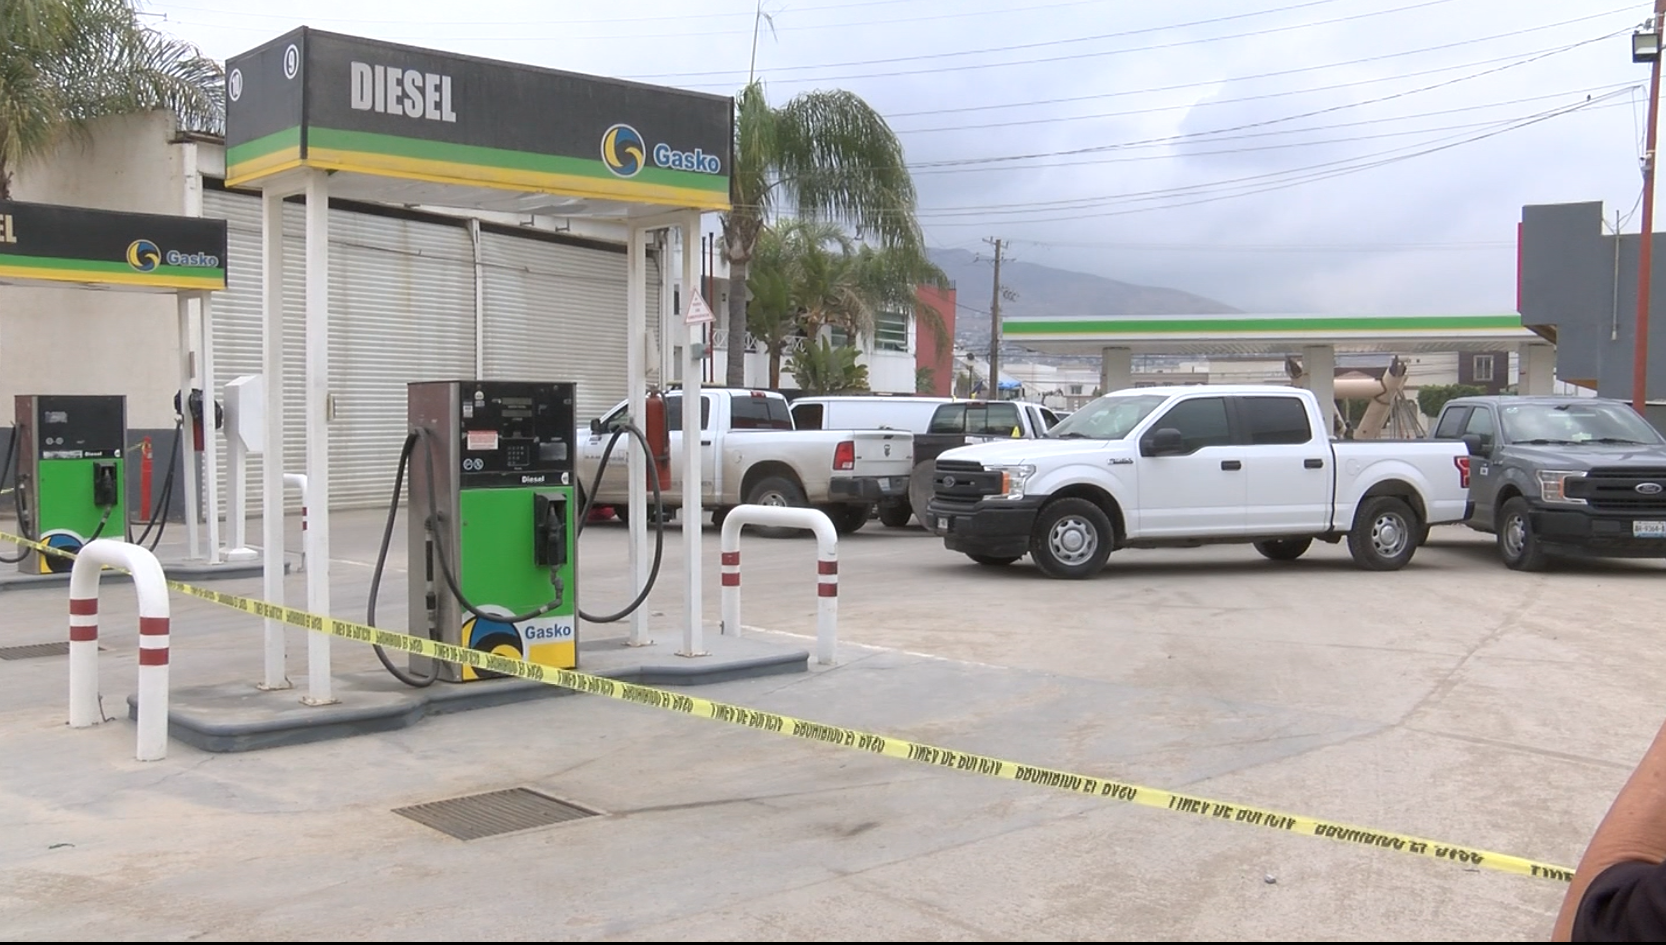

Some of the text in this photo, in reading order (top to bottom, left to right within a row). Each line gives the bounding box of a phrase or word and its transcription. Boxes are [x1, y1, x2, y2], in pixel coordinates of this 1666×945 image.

[350, 61, 456, 123] DIESEL
[653, 143, 720, 174] Gasko
[166, 250, 219, 268] Gasko
[522, 475, 545, 483] Diesel
[525, 624, 571, 639] Gasko
